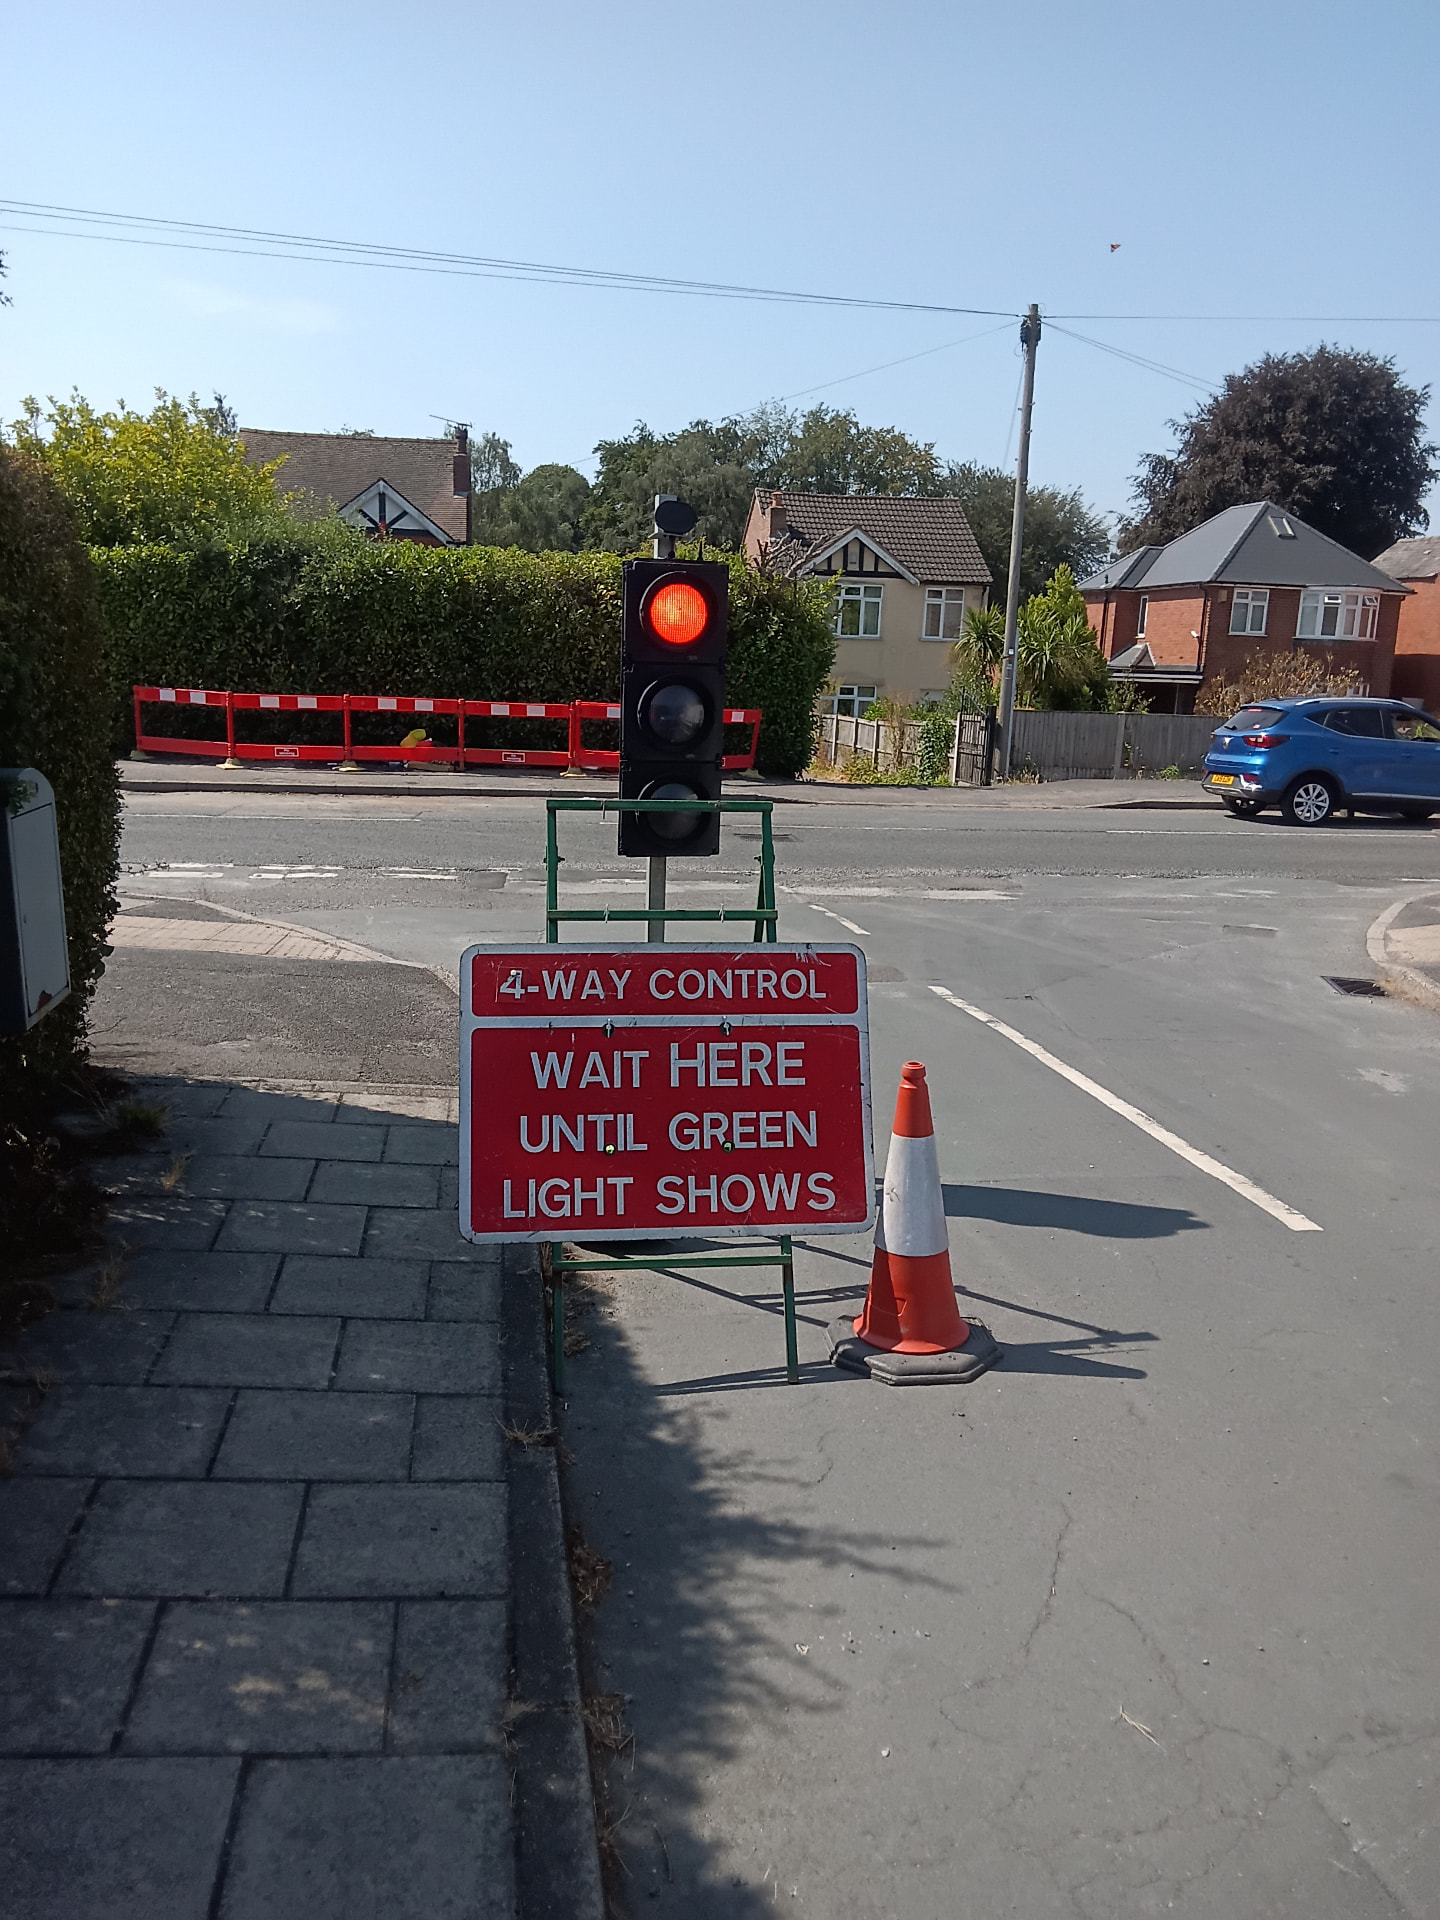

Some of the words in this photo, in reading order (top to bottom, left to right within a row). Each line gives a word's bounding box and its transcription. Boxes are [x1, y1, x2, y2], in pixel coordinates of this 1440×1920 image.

[499, 969, 632, 1000] 4-WAY
[649, 969, 827, 1000] CONTROL
[530, 1051, 650, 1089] WAIT
[669, 1042, 806, 1087] HERE
[519, 1113, 648, 1153] UNTIL
[669, 1110, 817, 1151] GREEN
[503, 1177, 634, 1219] LIGHT
[656, 1172, 836, 1215] SHOWS
